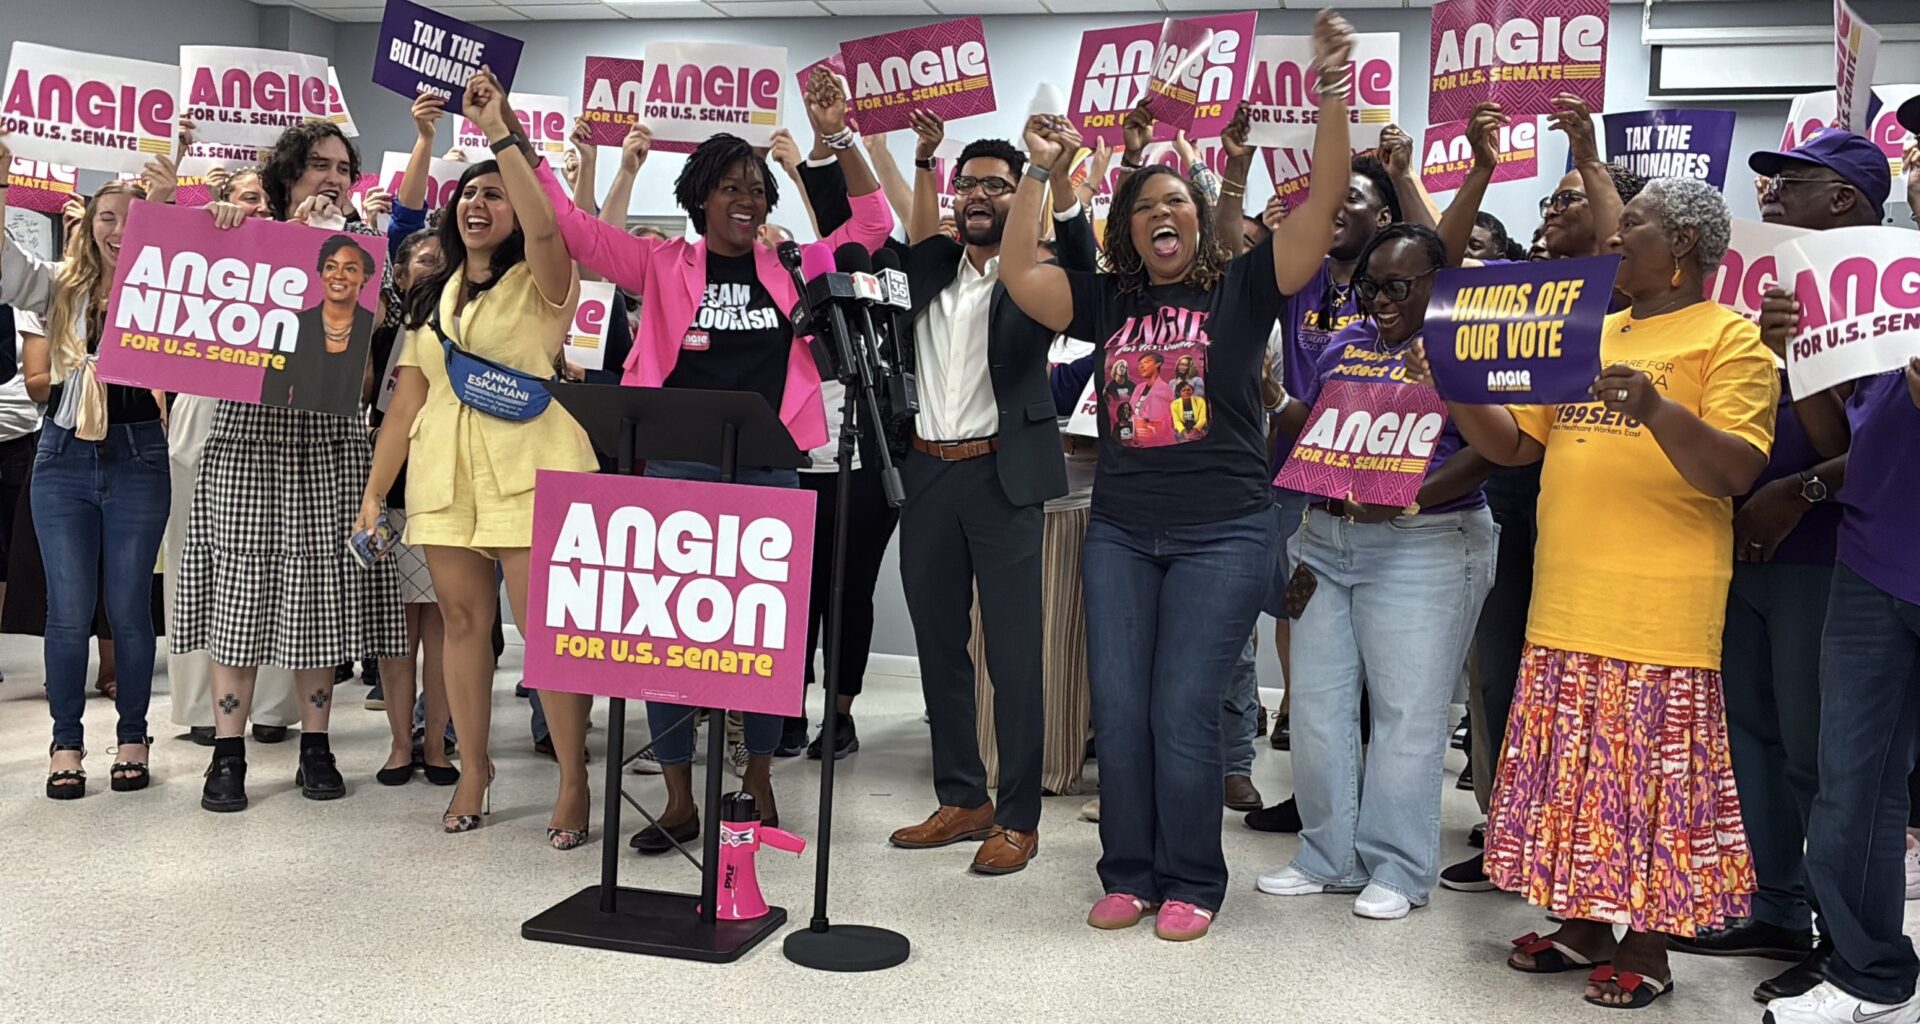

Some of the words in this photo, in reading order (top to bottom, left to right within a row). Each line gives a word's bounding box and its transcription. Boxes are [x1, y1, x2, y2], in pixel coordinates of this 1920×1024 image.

[411, 19, 443, 53] TAX
[450, 34, 485, 66] THE
[1434, 14, 1605, 76] ANGIE
[855, 41, 986, 99] ANGIE
[1432, 73, 1457, 92] FOR
[1459, 69, 1487, 84] U.S.
[1489, 64, 1563, 82] SENATE
[189, 67, 327, 116] ANGIE
[645, 63, 780, 110] ANGIE
[857, 97, 882, 112] FOR
[884, 92, 909, 106] U.S.
[912, 80, 966, 101] SENATE
[3, 69, 174, 138] ANGIE
[187, 107, 215, 122] FOR
[218, 110, 247, 125] U.S.
[250, 113, 304, 129] SENATE
[585, 110, 610, 123] FOR
[644, 105, 668, 119] FOR
[671, 106, 697, 121] U.S.
[699, 107, 750, 124] SENATE
[1273, 109, 1299, 123] U.S.
[1083, 113, 1116, 128] FOR
[33, 121, 67, 141] U.S.
[71, 128, 138, 152] SENATE
[459, 137, 479, 149] FOR
[1424, 122, 1536, 168] ANIE
[1625, 126, 1652, 151] TAX
[1657, 125, 1693, 150] THE
[209, 147, 257, 161] SENATE
[1423, 164, 1444, 176] FOR
[1446, 160, 1468, 172] U.S.
[1277, 179, 1300, 197] FOR
[124, 245, 309, 310] ANGIE
[1452, 283, 1533, 322] HANDS
[1534, 279, 1585, 317] OFF
[115, 285, 300, 353] NIXON
[1104, 306, 1209, 349] ANGIE
[120, 332, 160, 354] FOR
[163, 339, 202, 359] U.S.
[1454, 323, 1500, 361] OUR
[1505, 320, 1565, 360] VOTE
[1792, 333, 1823, 363] FOR
[1826, 324, 1867, 348] U.S.
[482, 371, 518, 388] ANNA
[1487, 370, 1531, 387] ANGIE
[1646, 360, 1675, 373] FOR
[467, 373, 530, 402] ESKAMANI
[1300, 408, 1443, 457] ANGIE
[1593, 425, 1622, 436] Workers
[1624, 428, 1641, 437] East
[1292, 446, 1321, 465] FOR
[1324, 450, 1350, 468] U.S.
[1353, 456, 1401, 472] SENATE
[550, 502, 793, 582] ANGIE
[545, 564, 787, 650] NIXON
[555, 633, 605, 660] FOR
[610, 639, 661, 665] U.S.
[724, 864, 735, 889] PYLE
